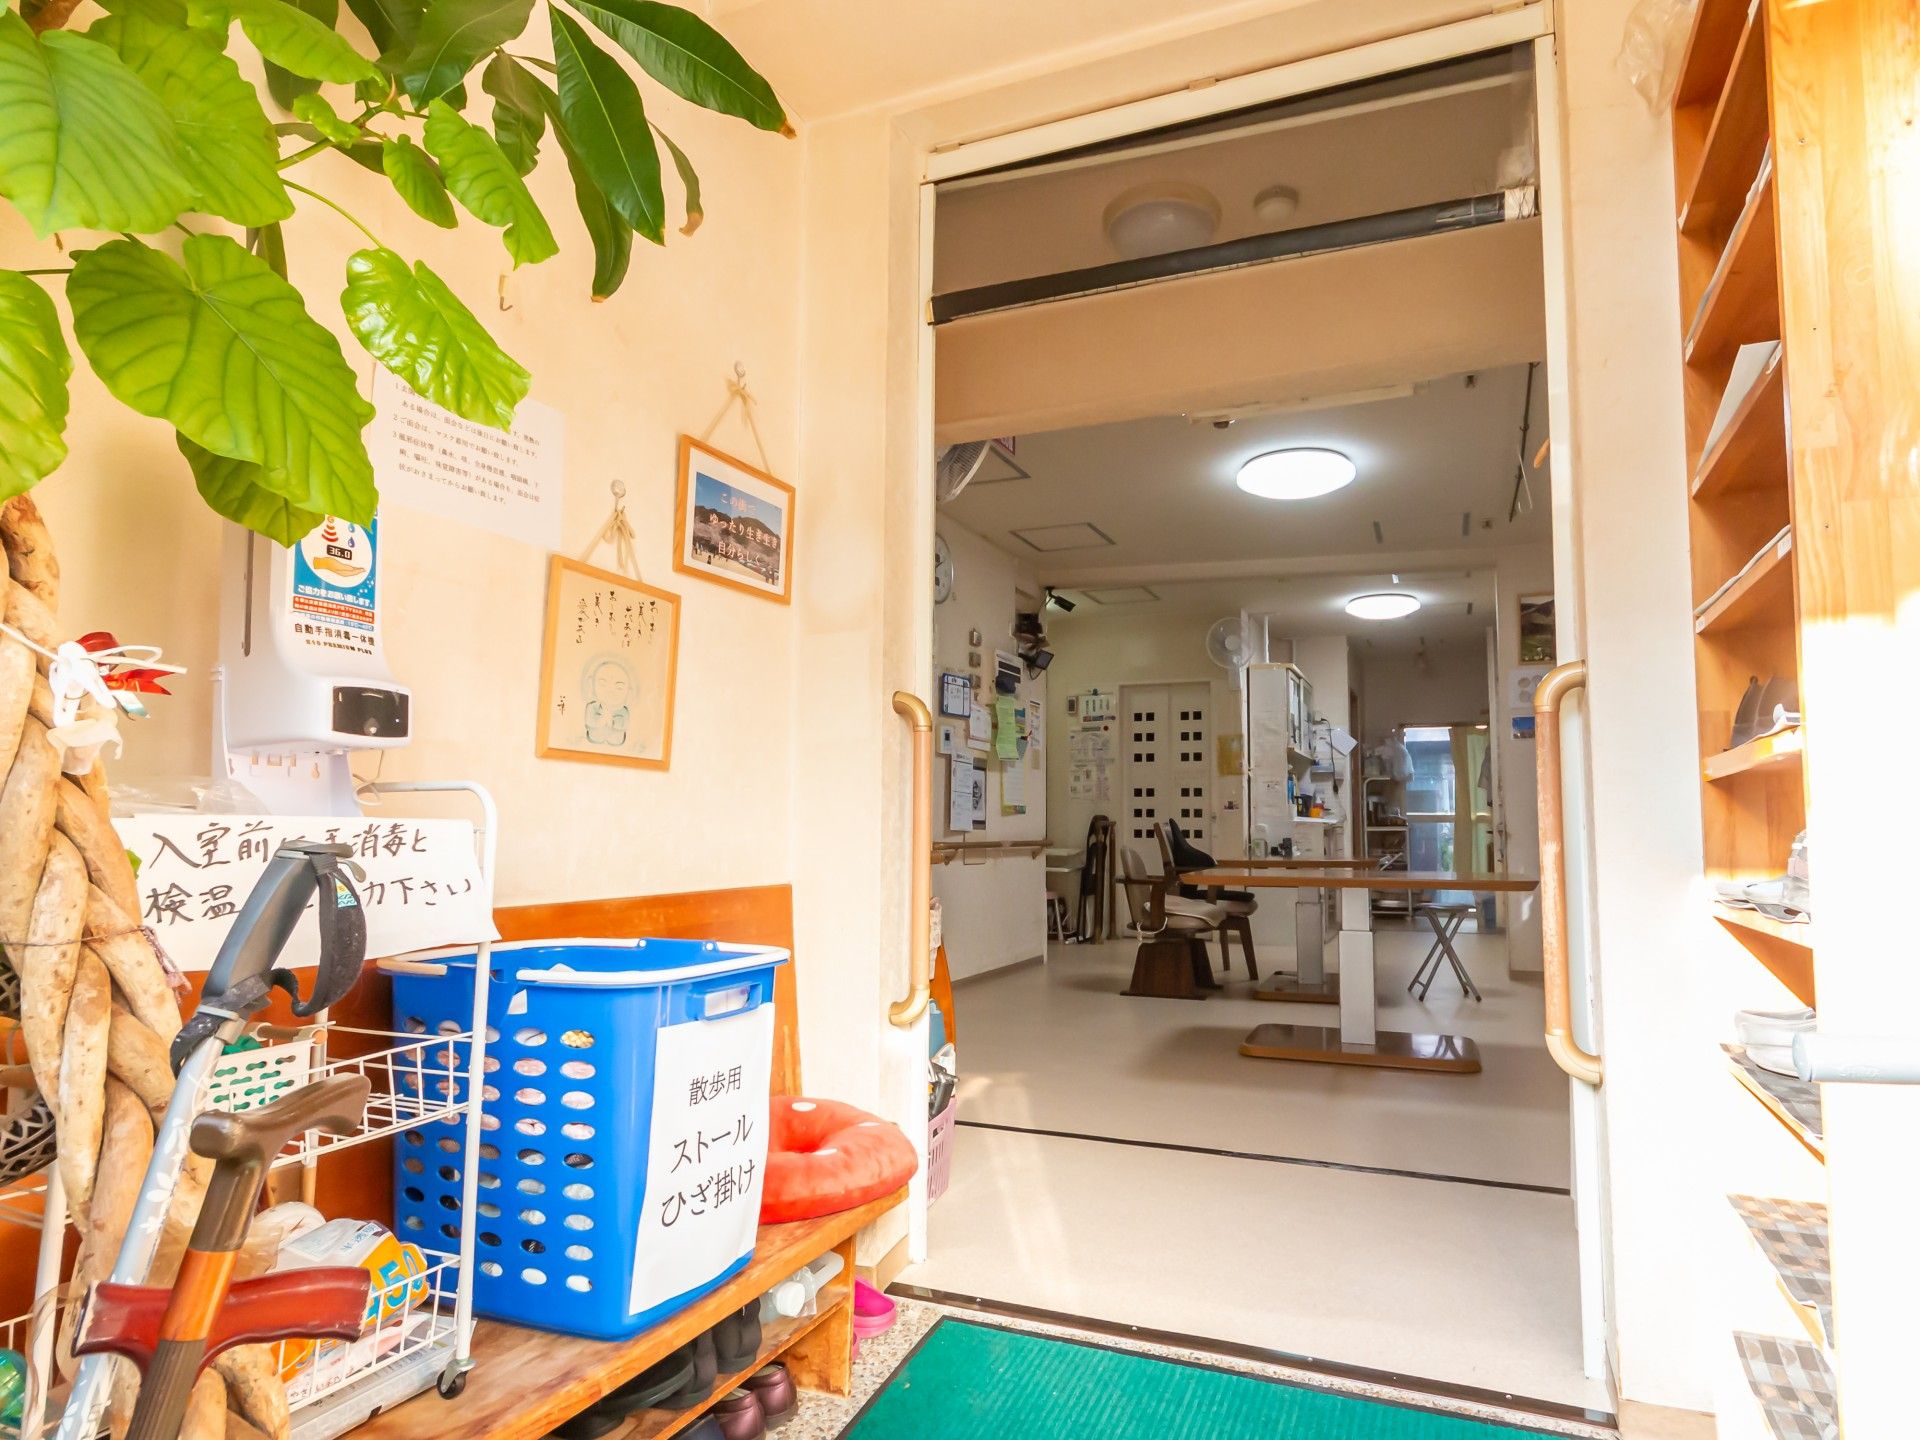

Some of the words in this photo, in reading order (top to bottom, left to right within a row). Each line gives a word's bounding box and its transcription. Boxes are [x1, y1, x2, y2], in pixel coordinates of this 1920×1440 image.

[709, 512, 778, 550] ゆったり生き生き
[329, 547, 351, 560] 36.0
[718, 540, 760, 566] 自分らしく
[294, 622, 375, 647] 自動手指消毒一体機
[688, 1065, 742, 1107] 散歩用
[670, 1114, 754, 1174] ストール
[660, 1159, 756, 1228] ひざ掛け
